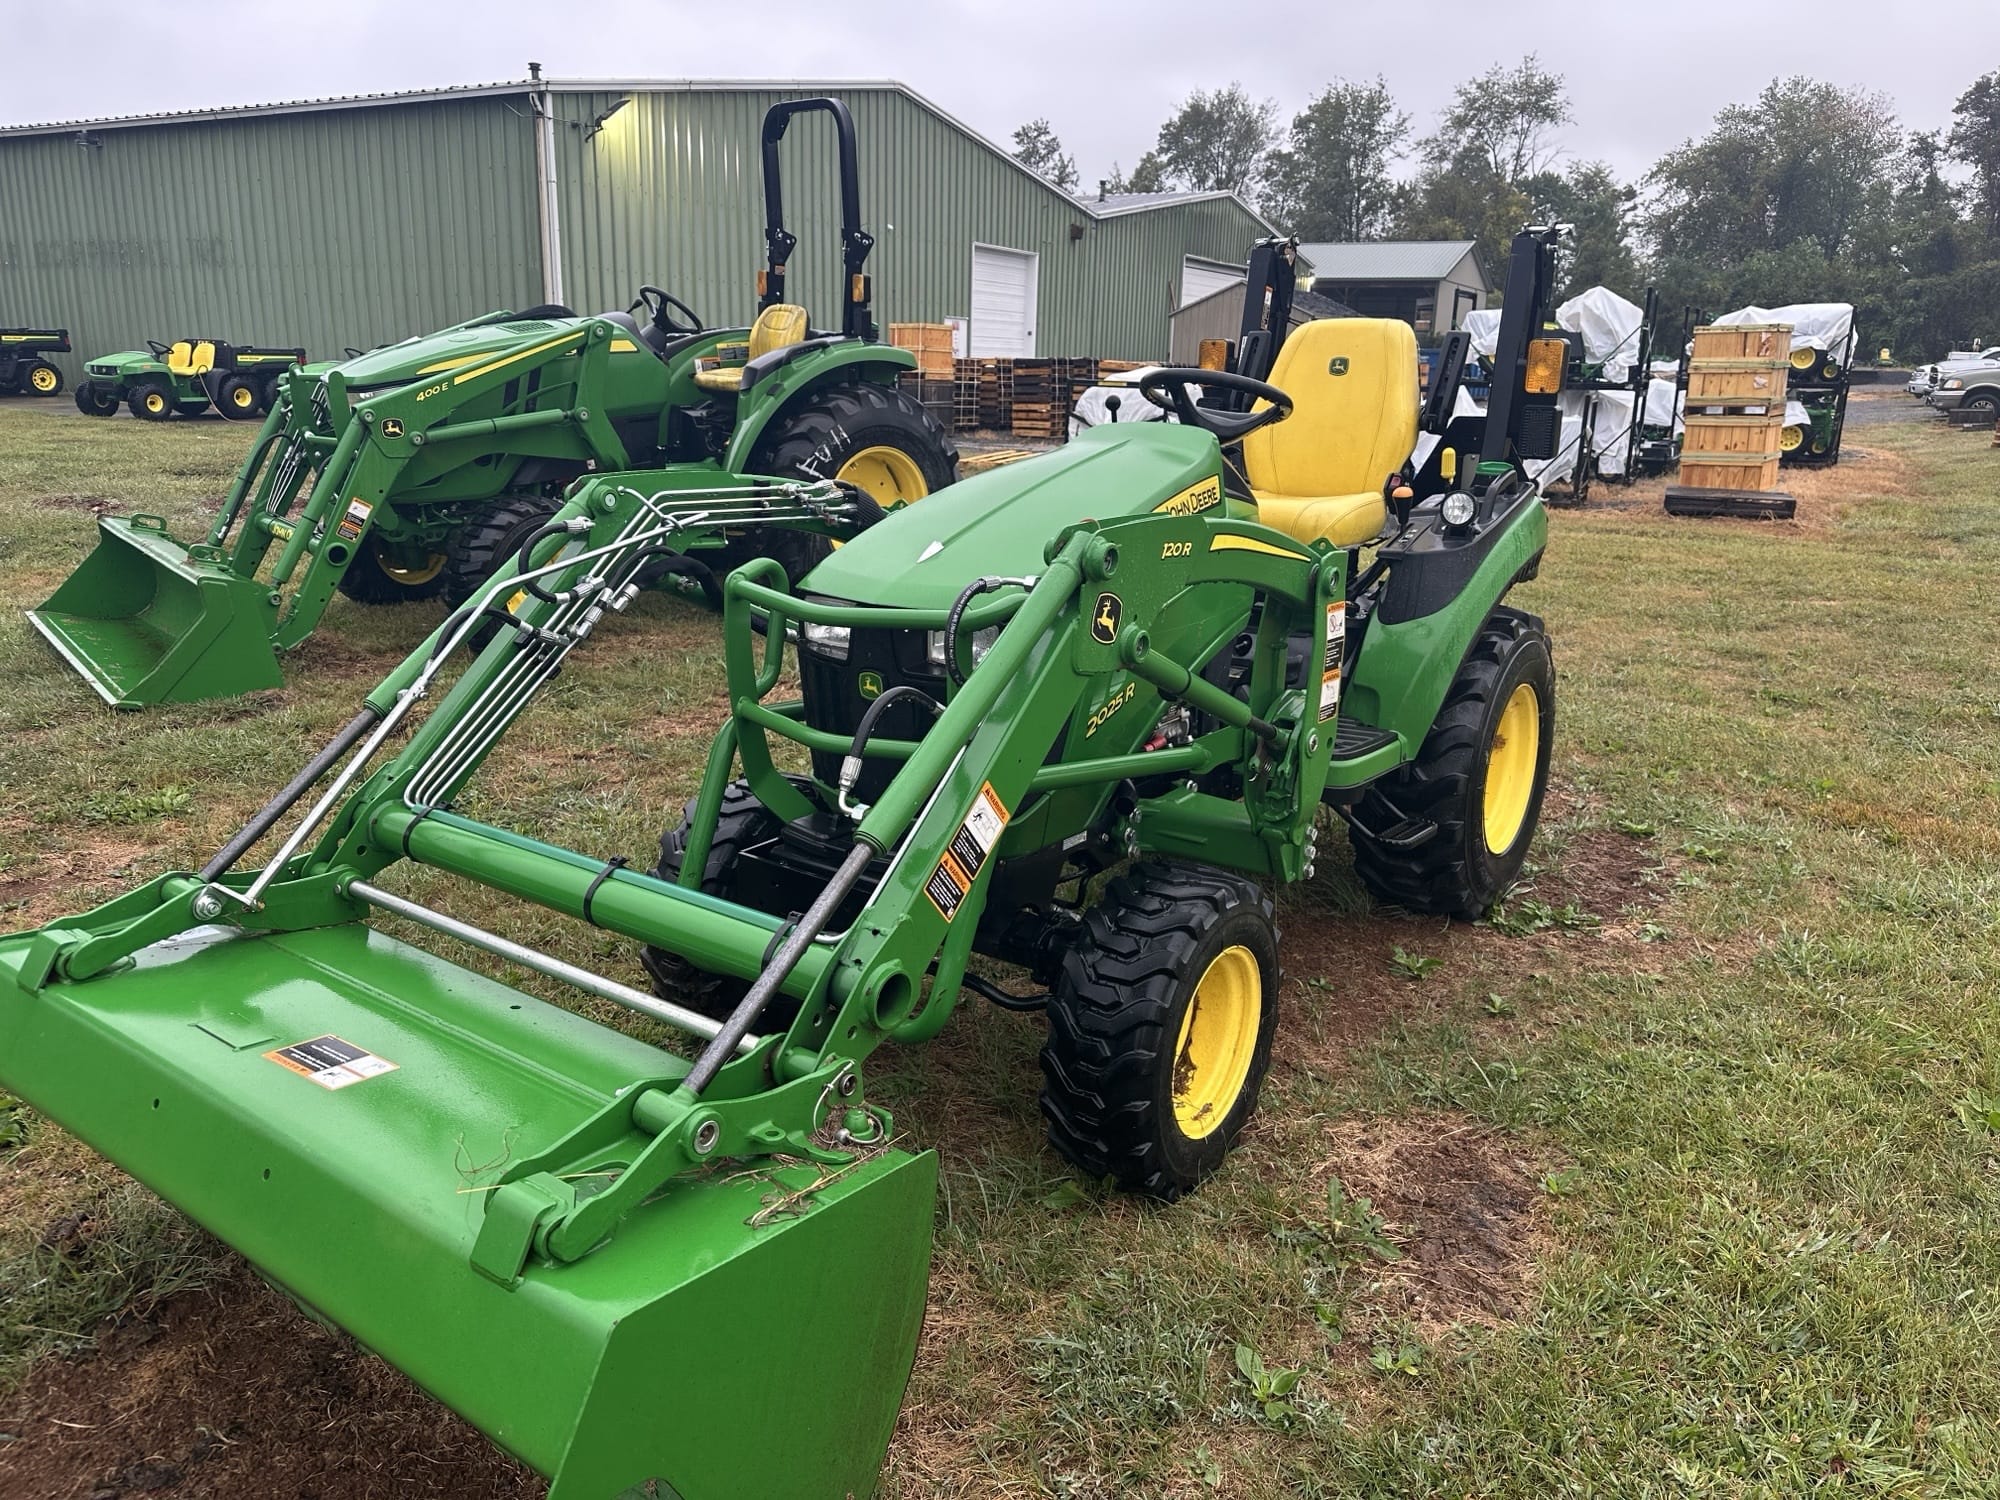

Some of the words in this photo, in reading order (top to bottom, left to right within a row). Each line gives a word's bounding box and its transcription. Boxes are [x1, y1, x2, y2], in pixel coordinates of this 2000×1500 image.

[416, 385, 441, 402] 400
[441, 381, 449, 392] E
[1190, 486, 1218, 511] DEERE
[1161, 542, 1183, 560] 120
[1182, 542, 1193, 556] R
[1085, 691, 1124, 739] 2025
[1125, 682, 1136, 703] R
[989, 793, 1006, 820] WARNING
[949, 864, 968, 891] WARNING
